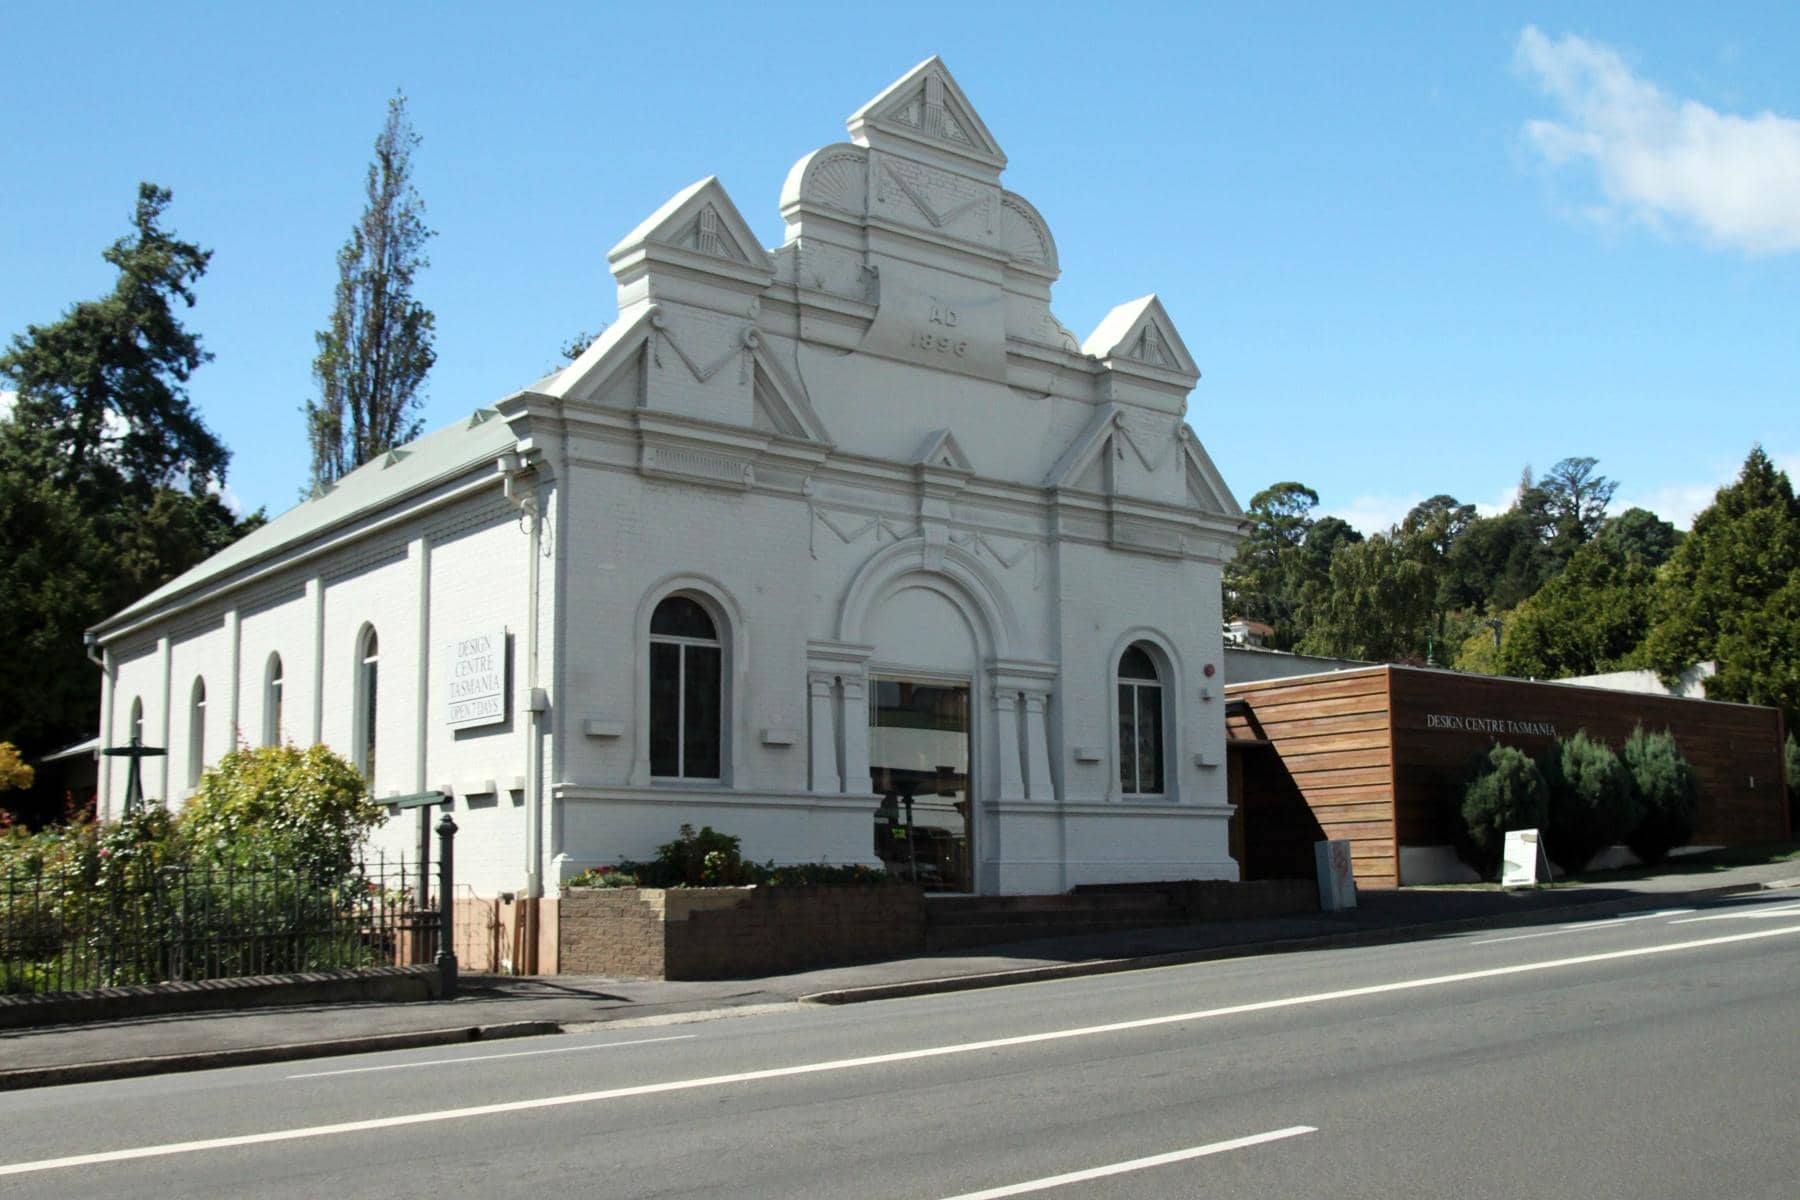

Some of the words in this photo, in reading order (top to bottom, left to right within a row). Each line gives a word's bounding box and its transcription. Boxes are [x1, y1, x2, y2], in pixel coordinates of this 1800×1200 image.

[457, 636, 491, 658] DESIGN
[455, 654, 494, 678] CENTRE
[448, 674, 500, 699] TASMANIA
[450, 704, 471, 720] OPEN
[477, 698, 499, 716] DAYS
[1426, 713, 1463, 729] DESIGN
[1465, 717, 1505, 733] CENTRE
[1506, 720, 1557, 736] TASMANIA
